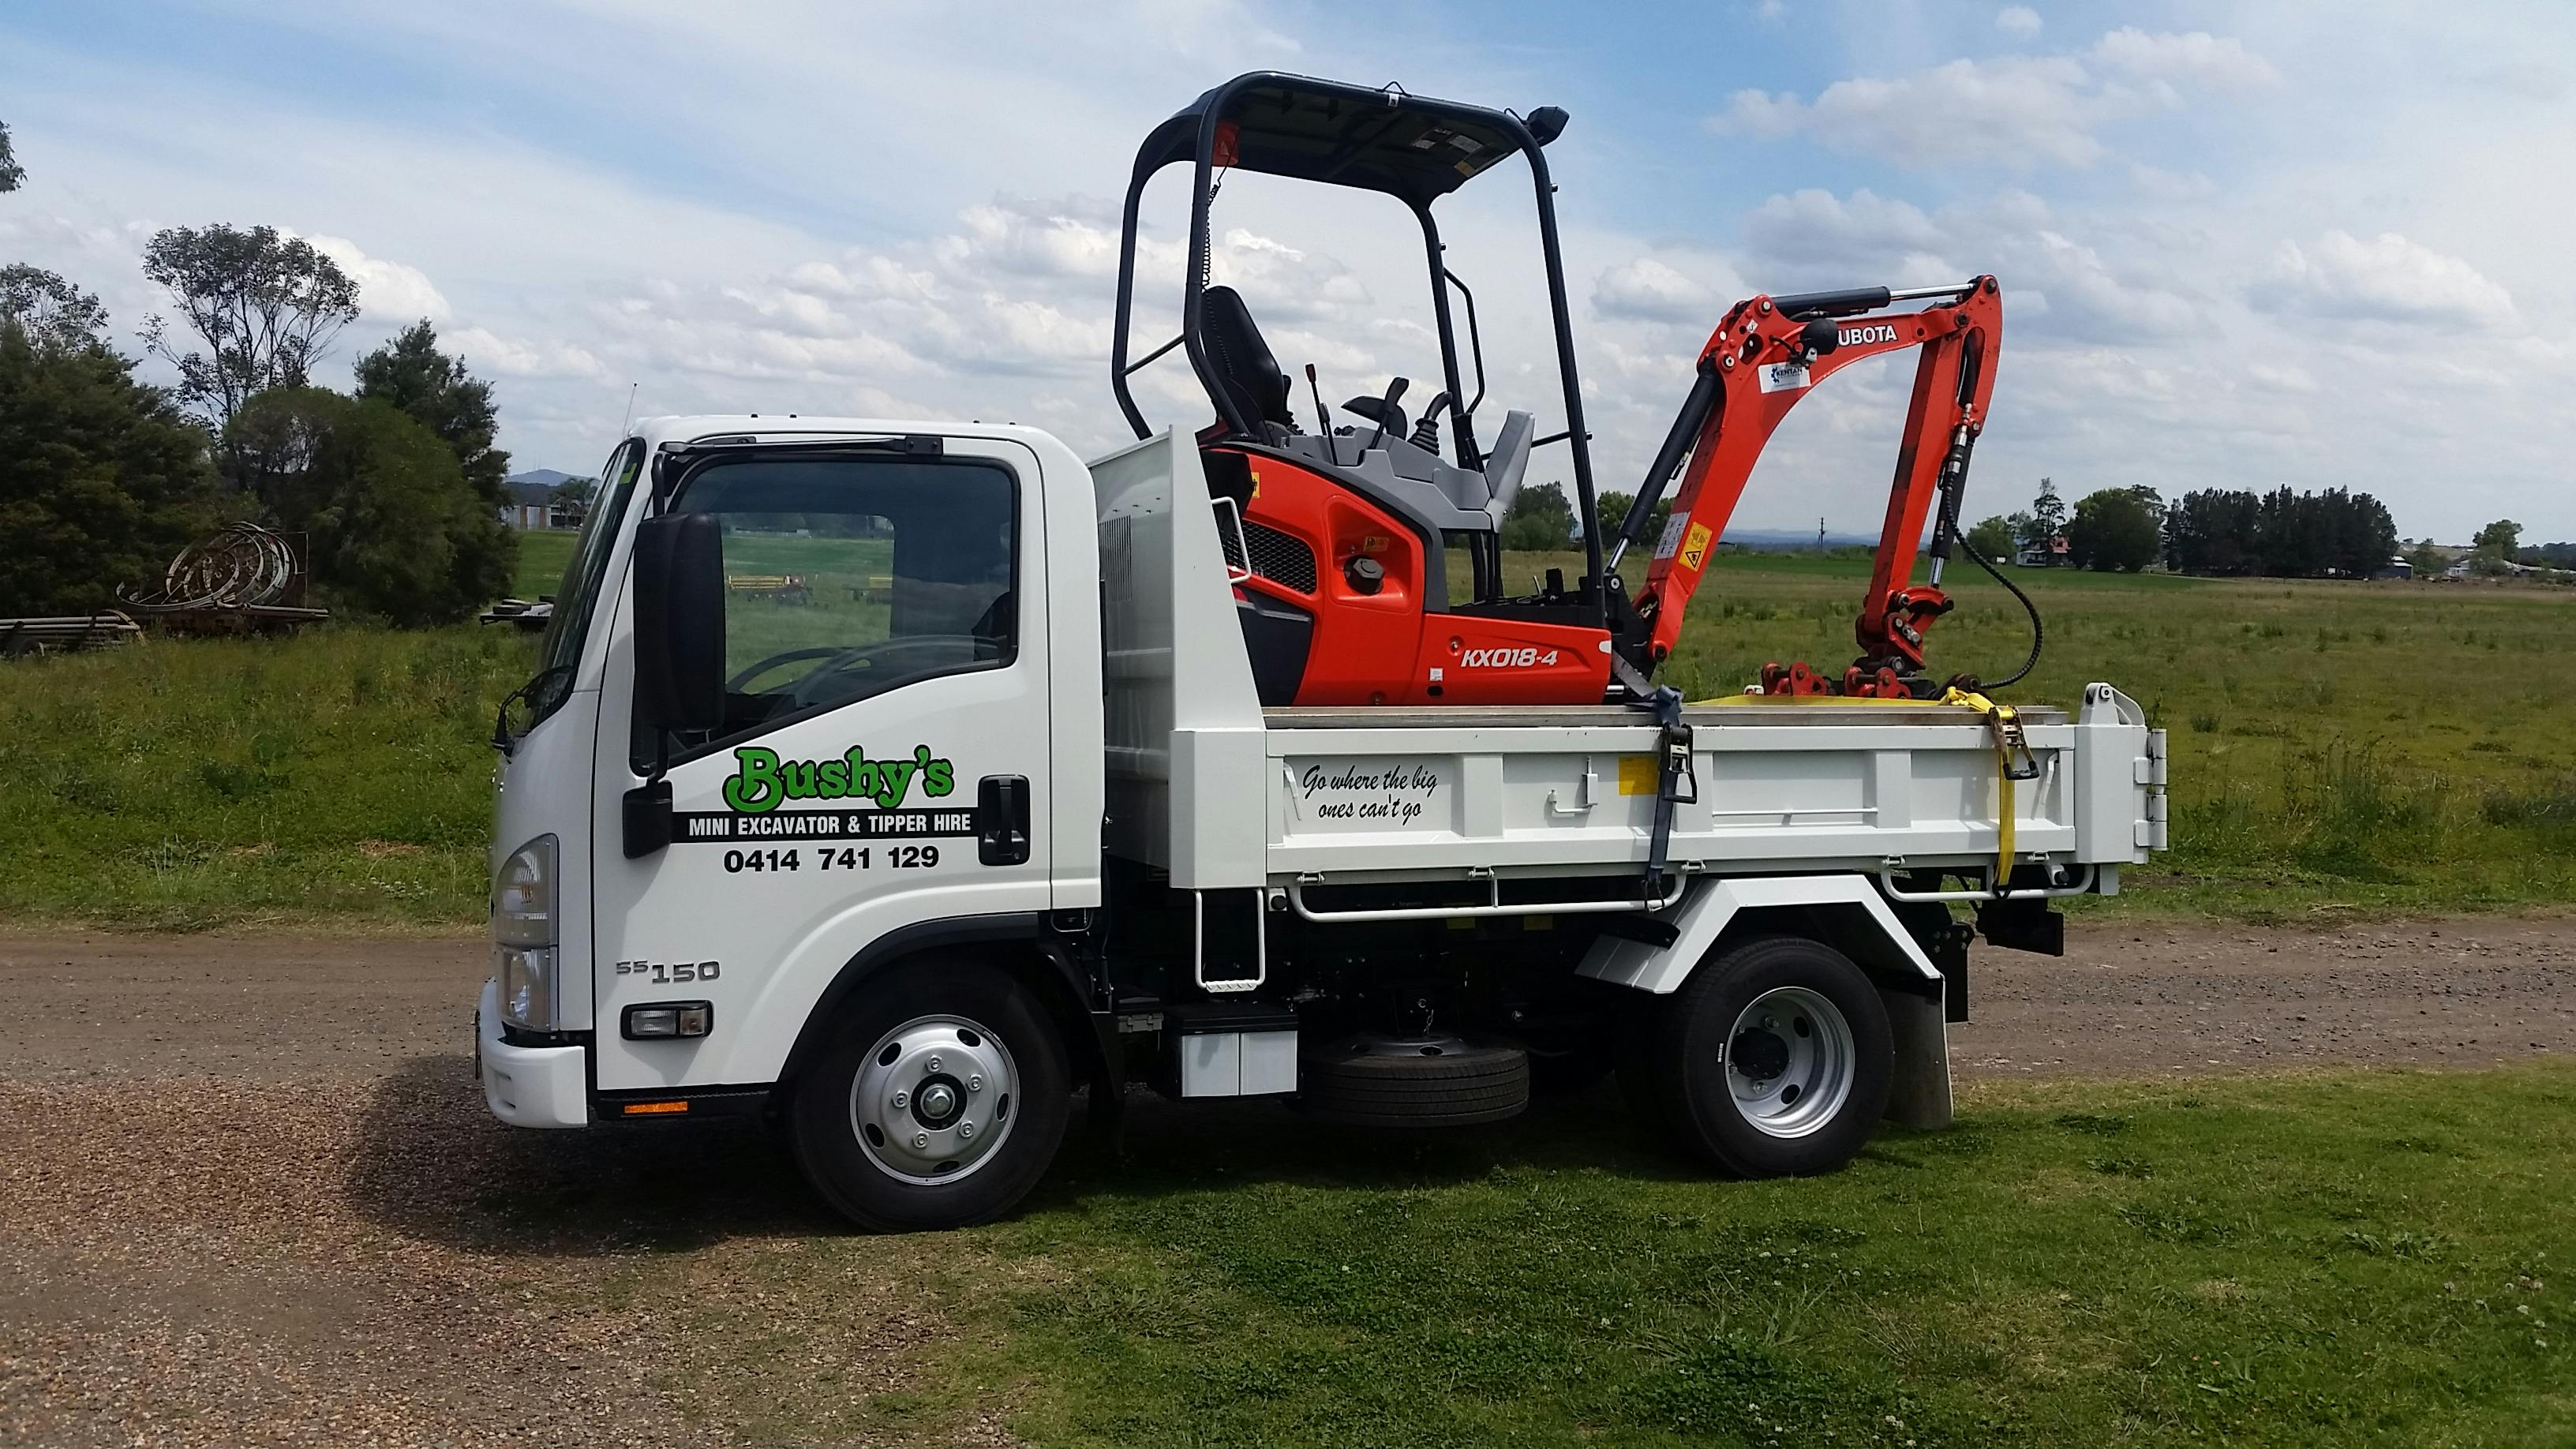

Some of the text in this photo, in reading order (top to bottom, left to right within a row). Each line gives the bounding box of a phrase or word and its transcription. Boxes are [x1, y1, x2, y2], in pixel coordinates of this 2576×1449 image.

[1837, 325, 1898, 346] UBOTA
[1461, 649, 1558, 667] KX018-4
[722, 744, 955, 813] Bushy's
[1303, 764, 1438, 799] Go where the big
[1318, 793, 1421, 826] ones can't go
[689, 814, 972, 836] MINI EXCAVATOR & TIPPER HIRE
[724, 845, 939, 873] 0414 741 129
